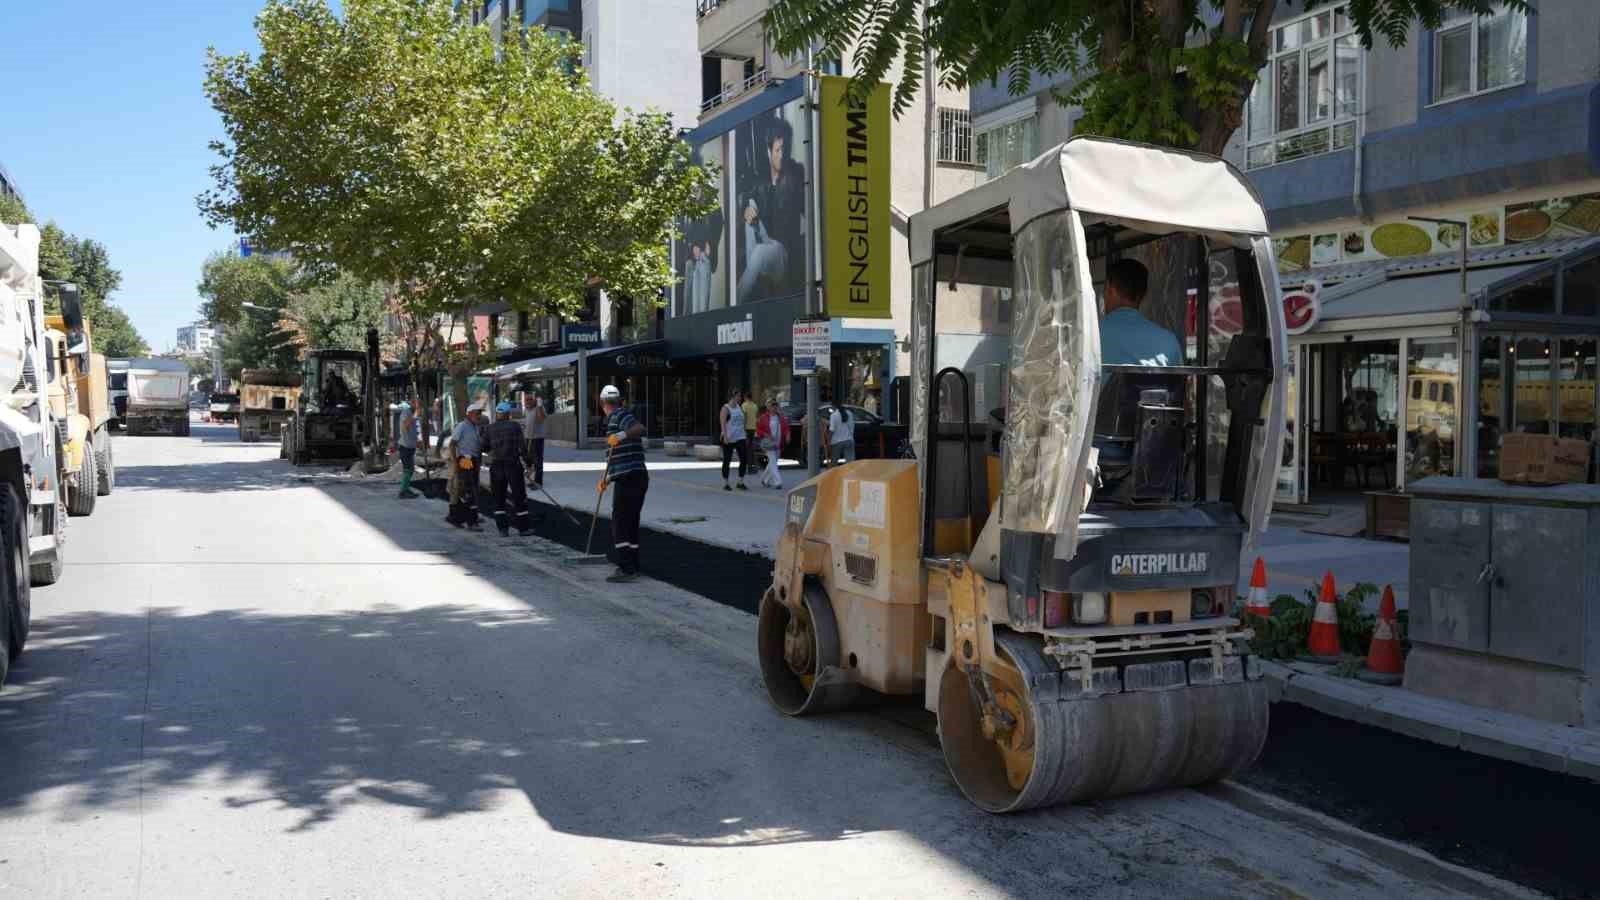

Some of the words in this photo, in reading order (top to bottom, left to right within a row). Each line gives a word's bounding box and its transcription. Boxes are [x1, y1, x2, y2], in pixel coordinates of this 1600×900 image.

[848, 175, 870, 304] ENGLISH
[568, 331, 599, 342] mavi
[717, 313, 753, 345] mavi
[1111, 552, 1207, 575] CATERPILLAR
